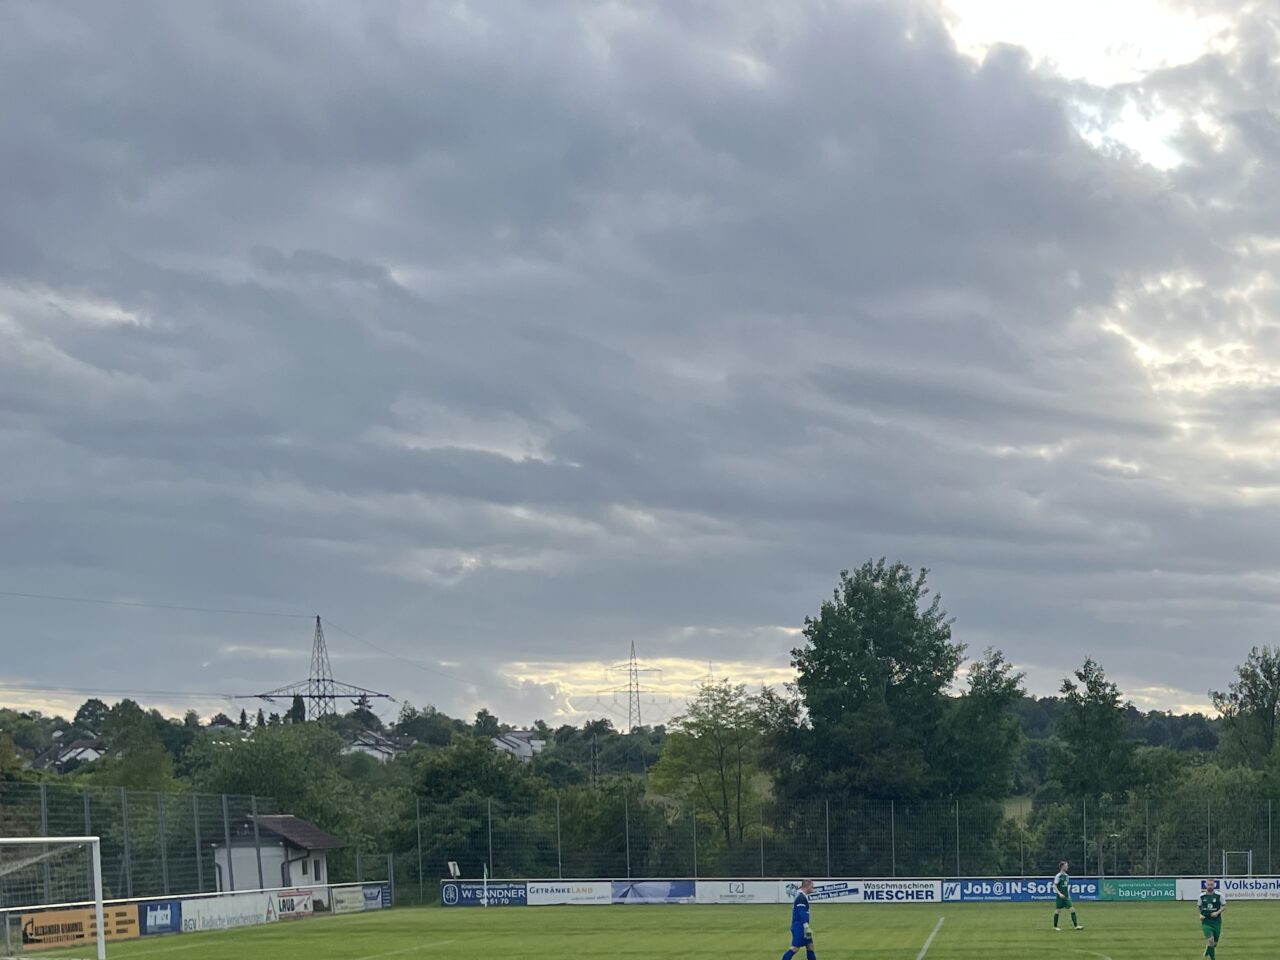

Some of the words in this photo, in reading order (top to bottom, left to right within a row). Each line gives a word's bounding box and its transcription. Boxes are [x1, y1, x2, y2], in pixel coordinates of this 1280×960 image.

[863, 882, 934, 890] Waschmaschinen
[461, 890, 474, 898] W.
[475, 889, 525, 898] SANDNER
[863, 890, 934, 900] MESCHER
[1118, 888, 1163, 899] bau+grün
[183, 918, 197, 930] BGV
